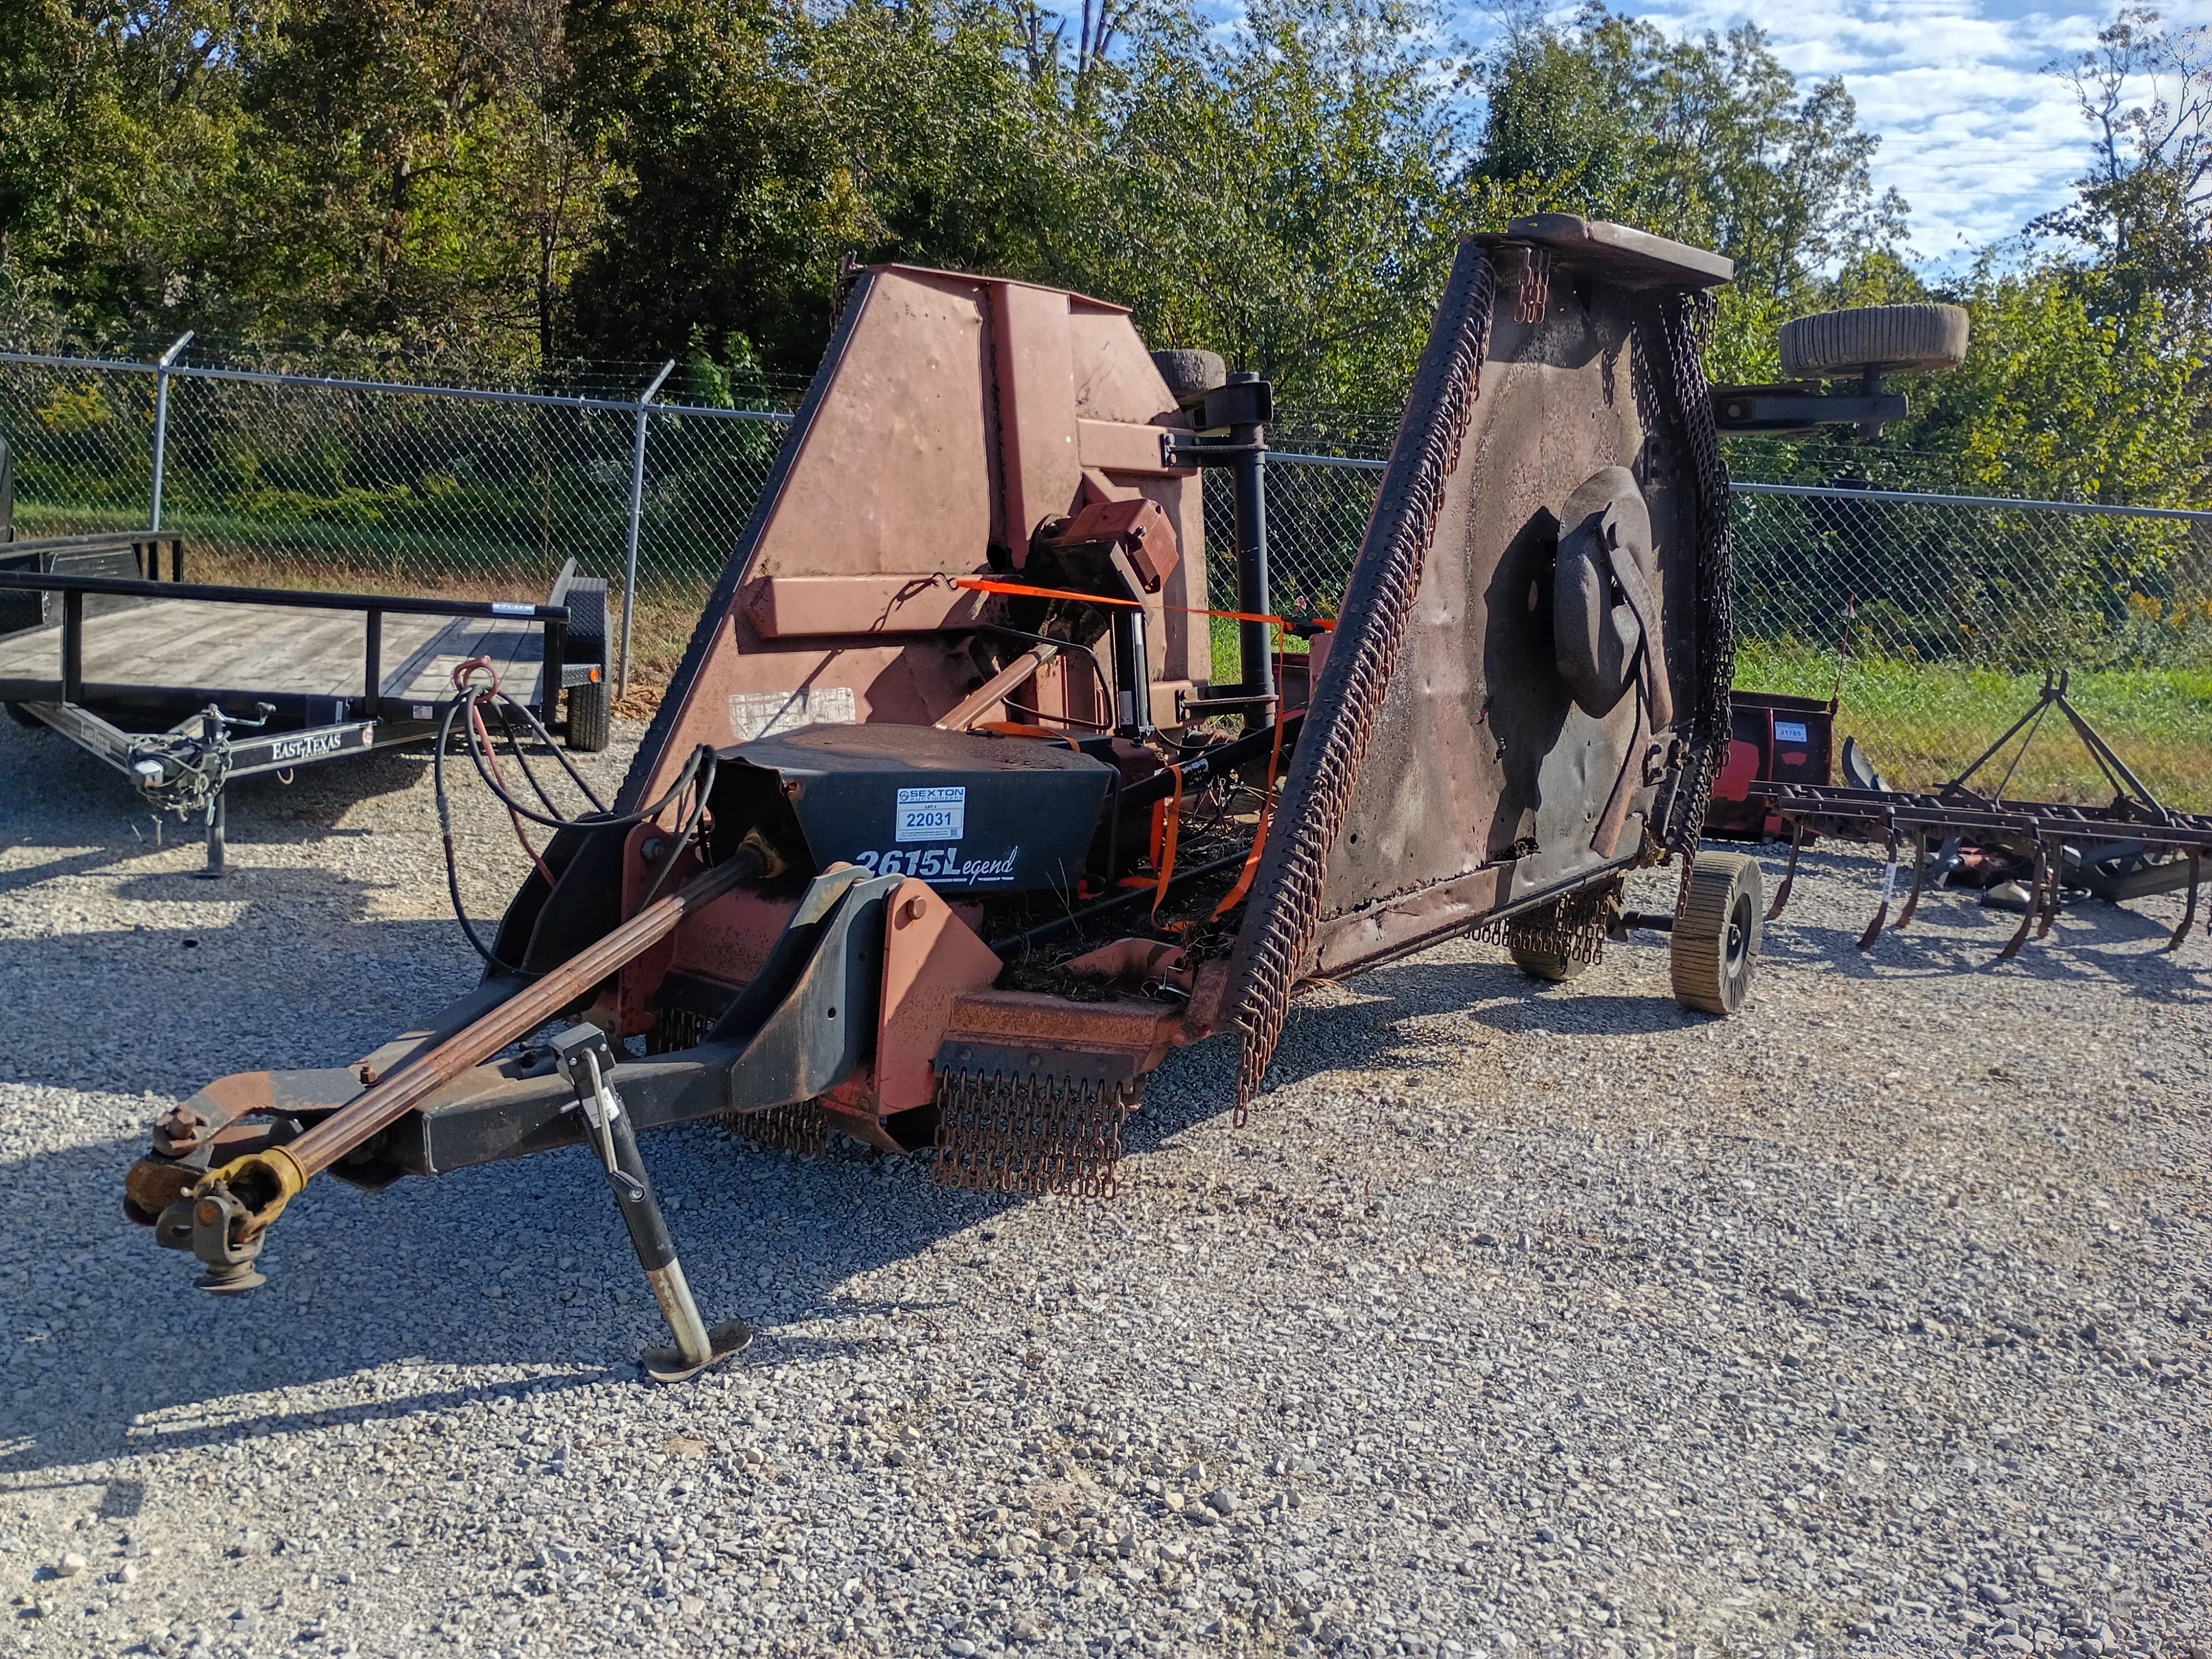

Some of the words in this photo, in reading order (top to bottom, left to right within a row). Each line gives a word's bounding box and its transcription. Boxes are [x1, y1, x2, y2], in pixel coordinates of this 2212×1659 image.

[272, 740, 303, 760] EAST
[304, 733, 341, 754] TEXAS
[910, 789, 964, 797] SEXTON
[906, 812, 951, 827] 22031
